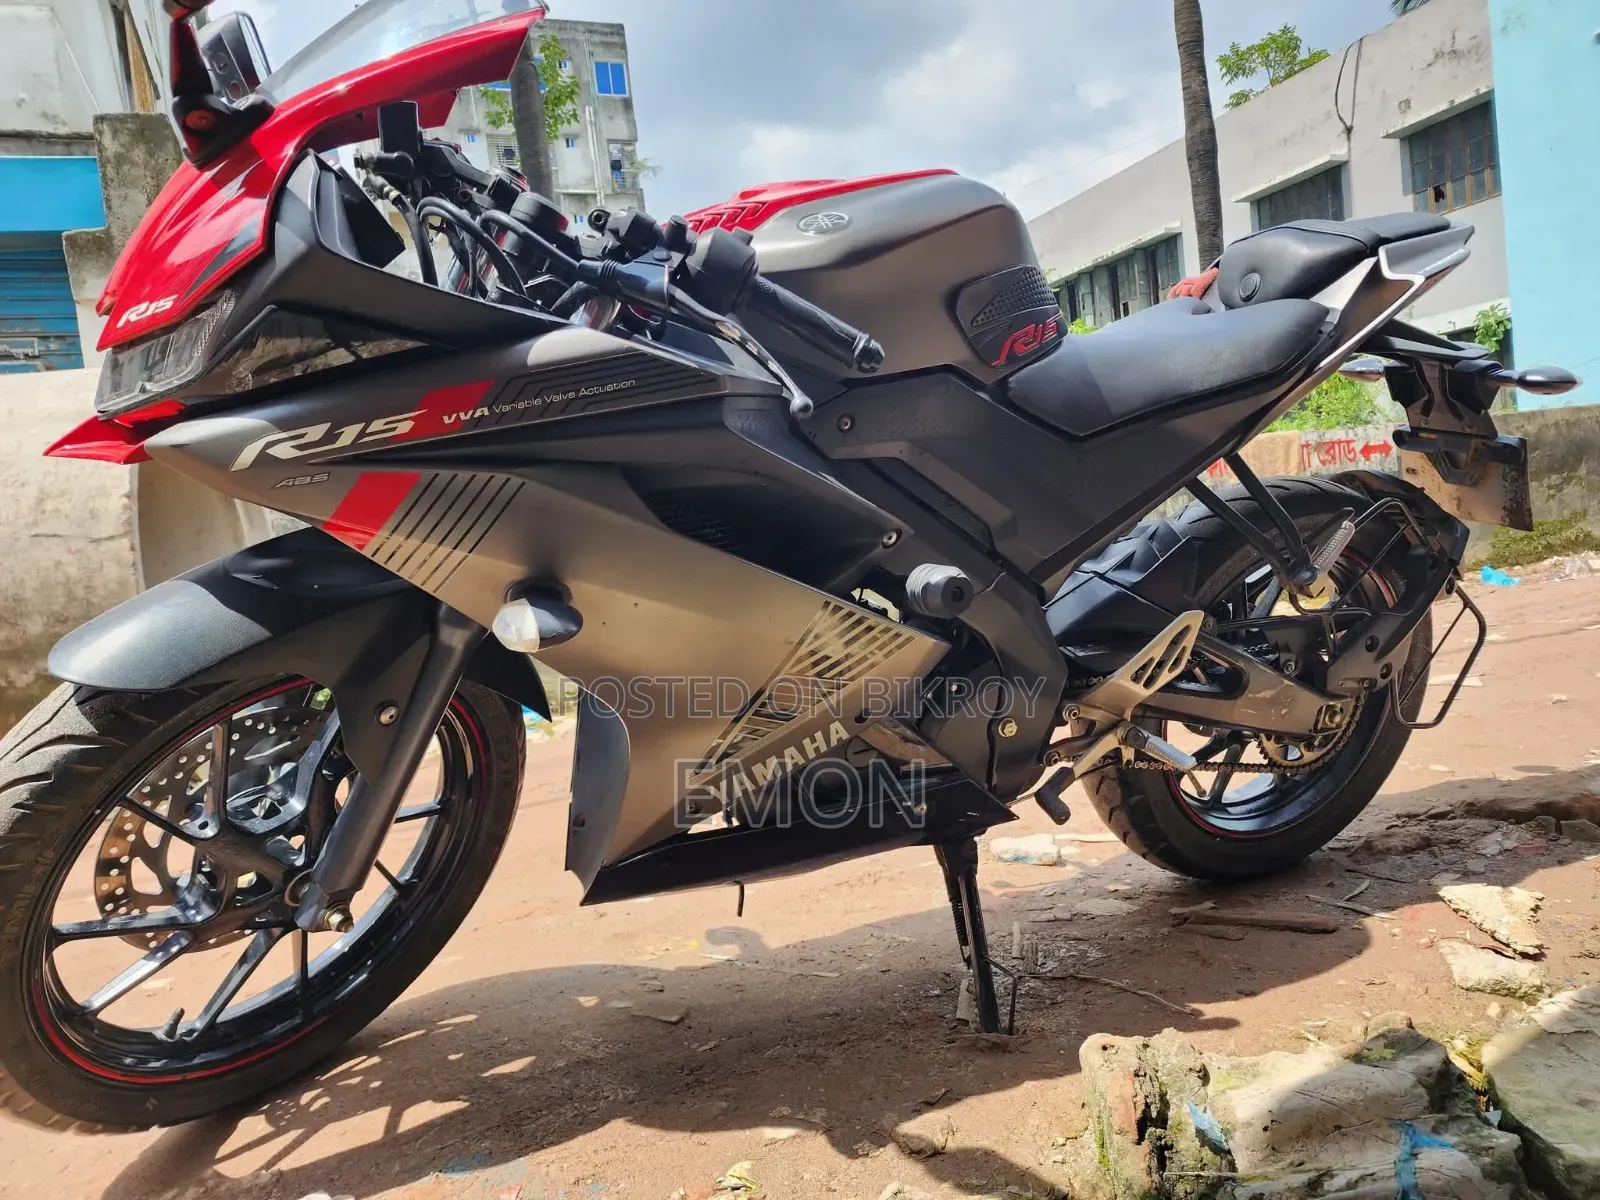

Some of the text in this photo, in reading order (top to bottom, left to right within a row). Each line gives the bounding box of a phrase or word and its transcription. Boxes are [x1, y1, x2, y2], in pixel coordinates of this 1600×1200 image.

[116, 294, 178, 328] R15
[991, 311, 1063, 367] R15
[442, 379, 636, 424] VVA Variable Valve Actuation
[230, 409, 429, 471] R15
[273, 472, 330, 489] ABS
[706, 720, 850, 804] YAMAHA
